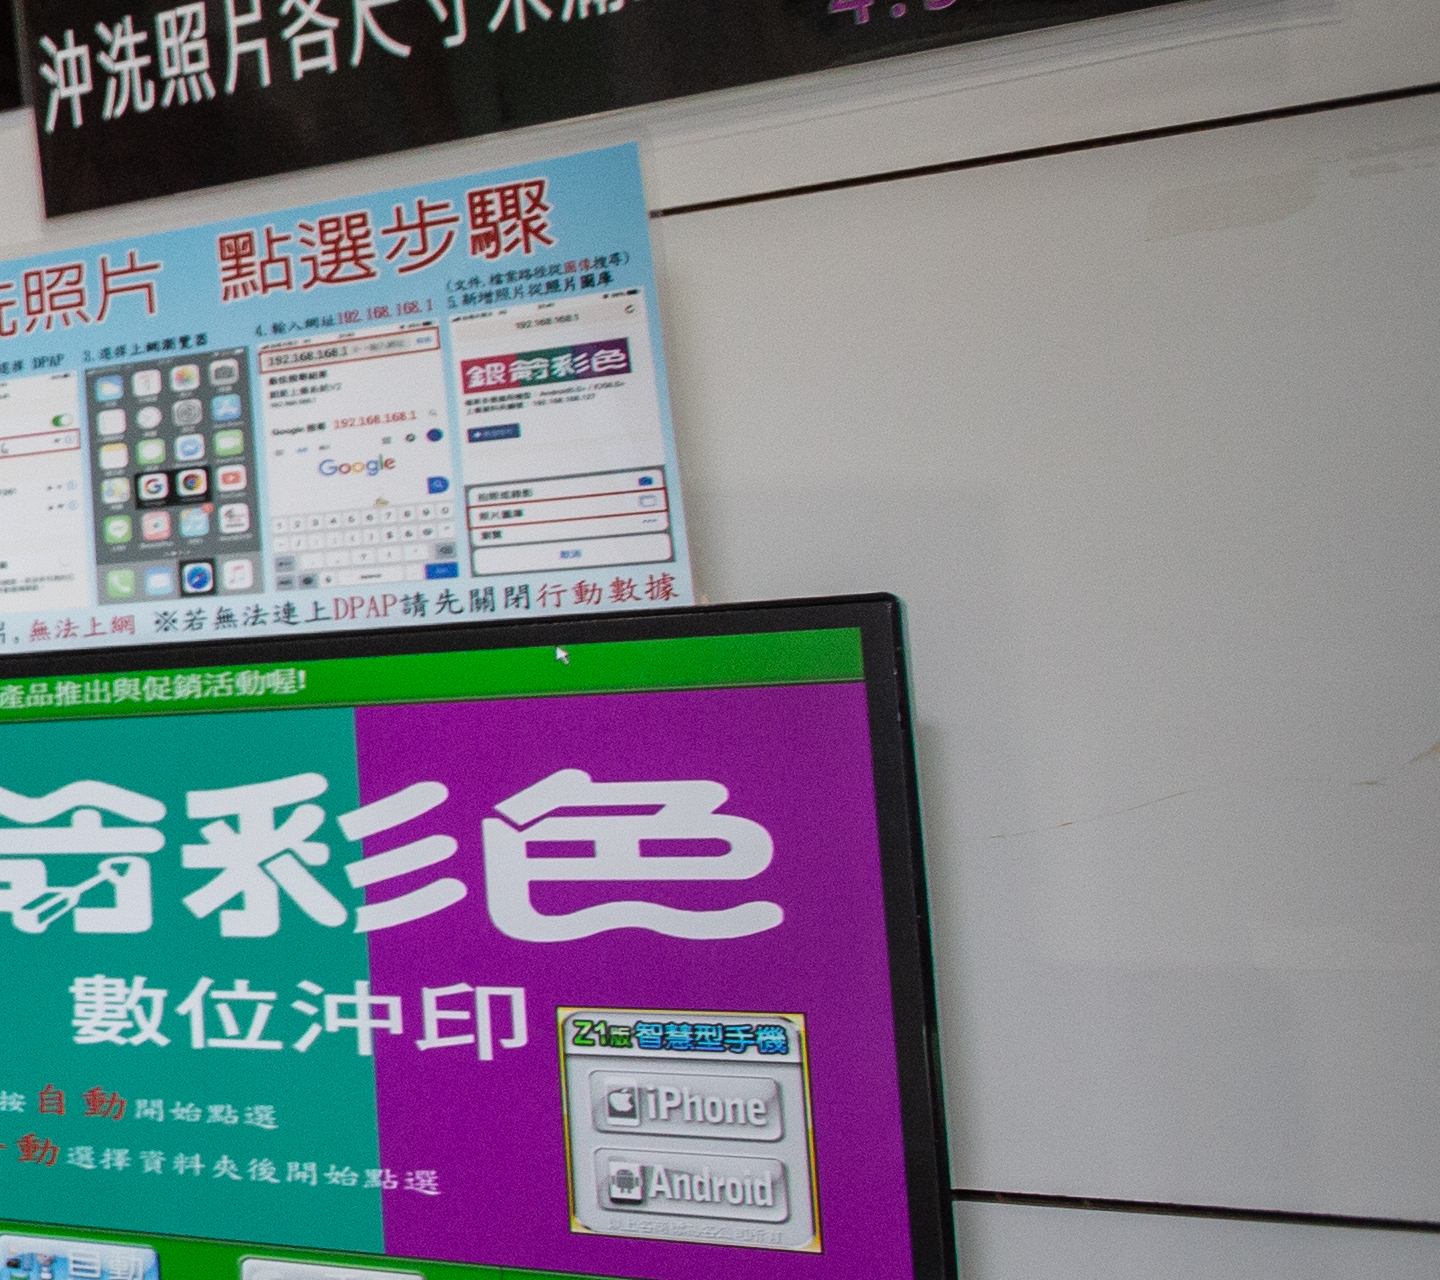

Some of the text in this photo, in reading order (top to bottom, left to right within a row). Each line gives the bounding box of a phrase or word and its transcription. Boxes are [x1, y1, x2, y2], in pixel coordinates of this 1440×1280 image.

[216, 175, 556, 305] 點選步驟
[318, 453, 396, 478] Google
[66, 972, 532, 1063] 數位沖印
[645, 1084, 768, 1127] iPhone
[647, 1164, 775, 1207] Android
